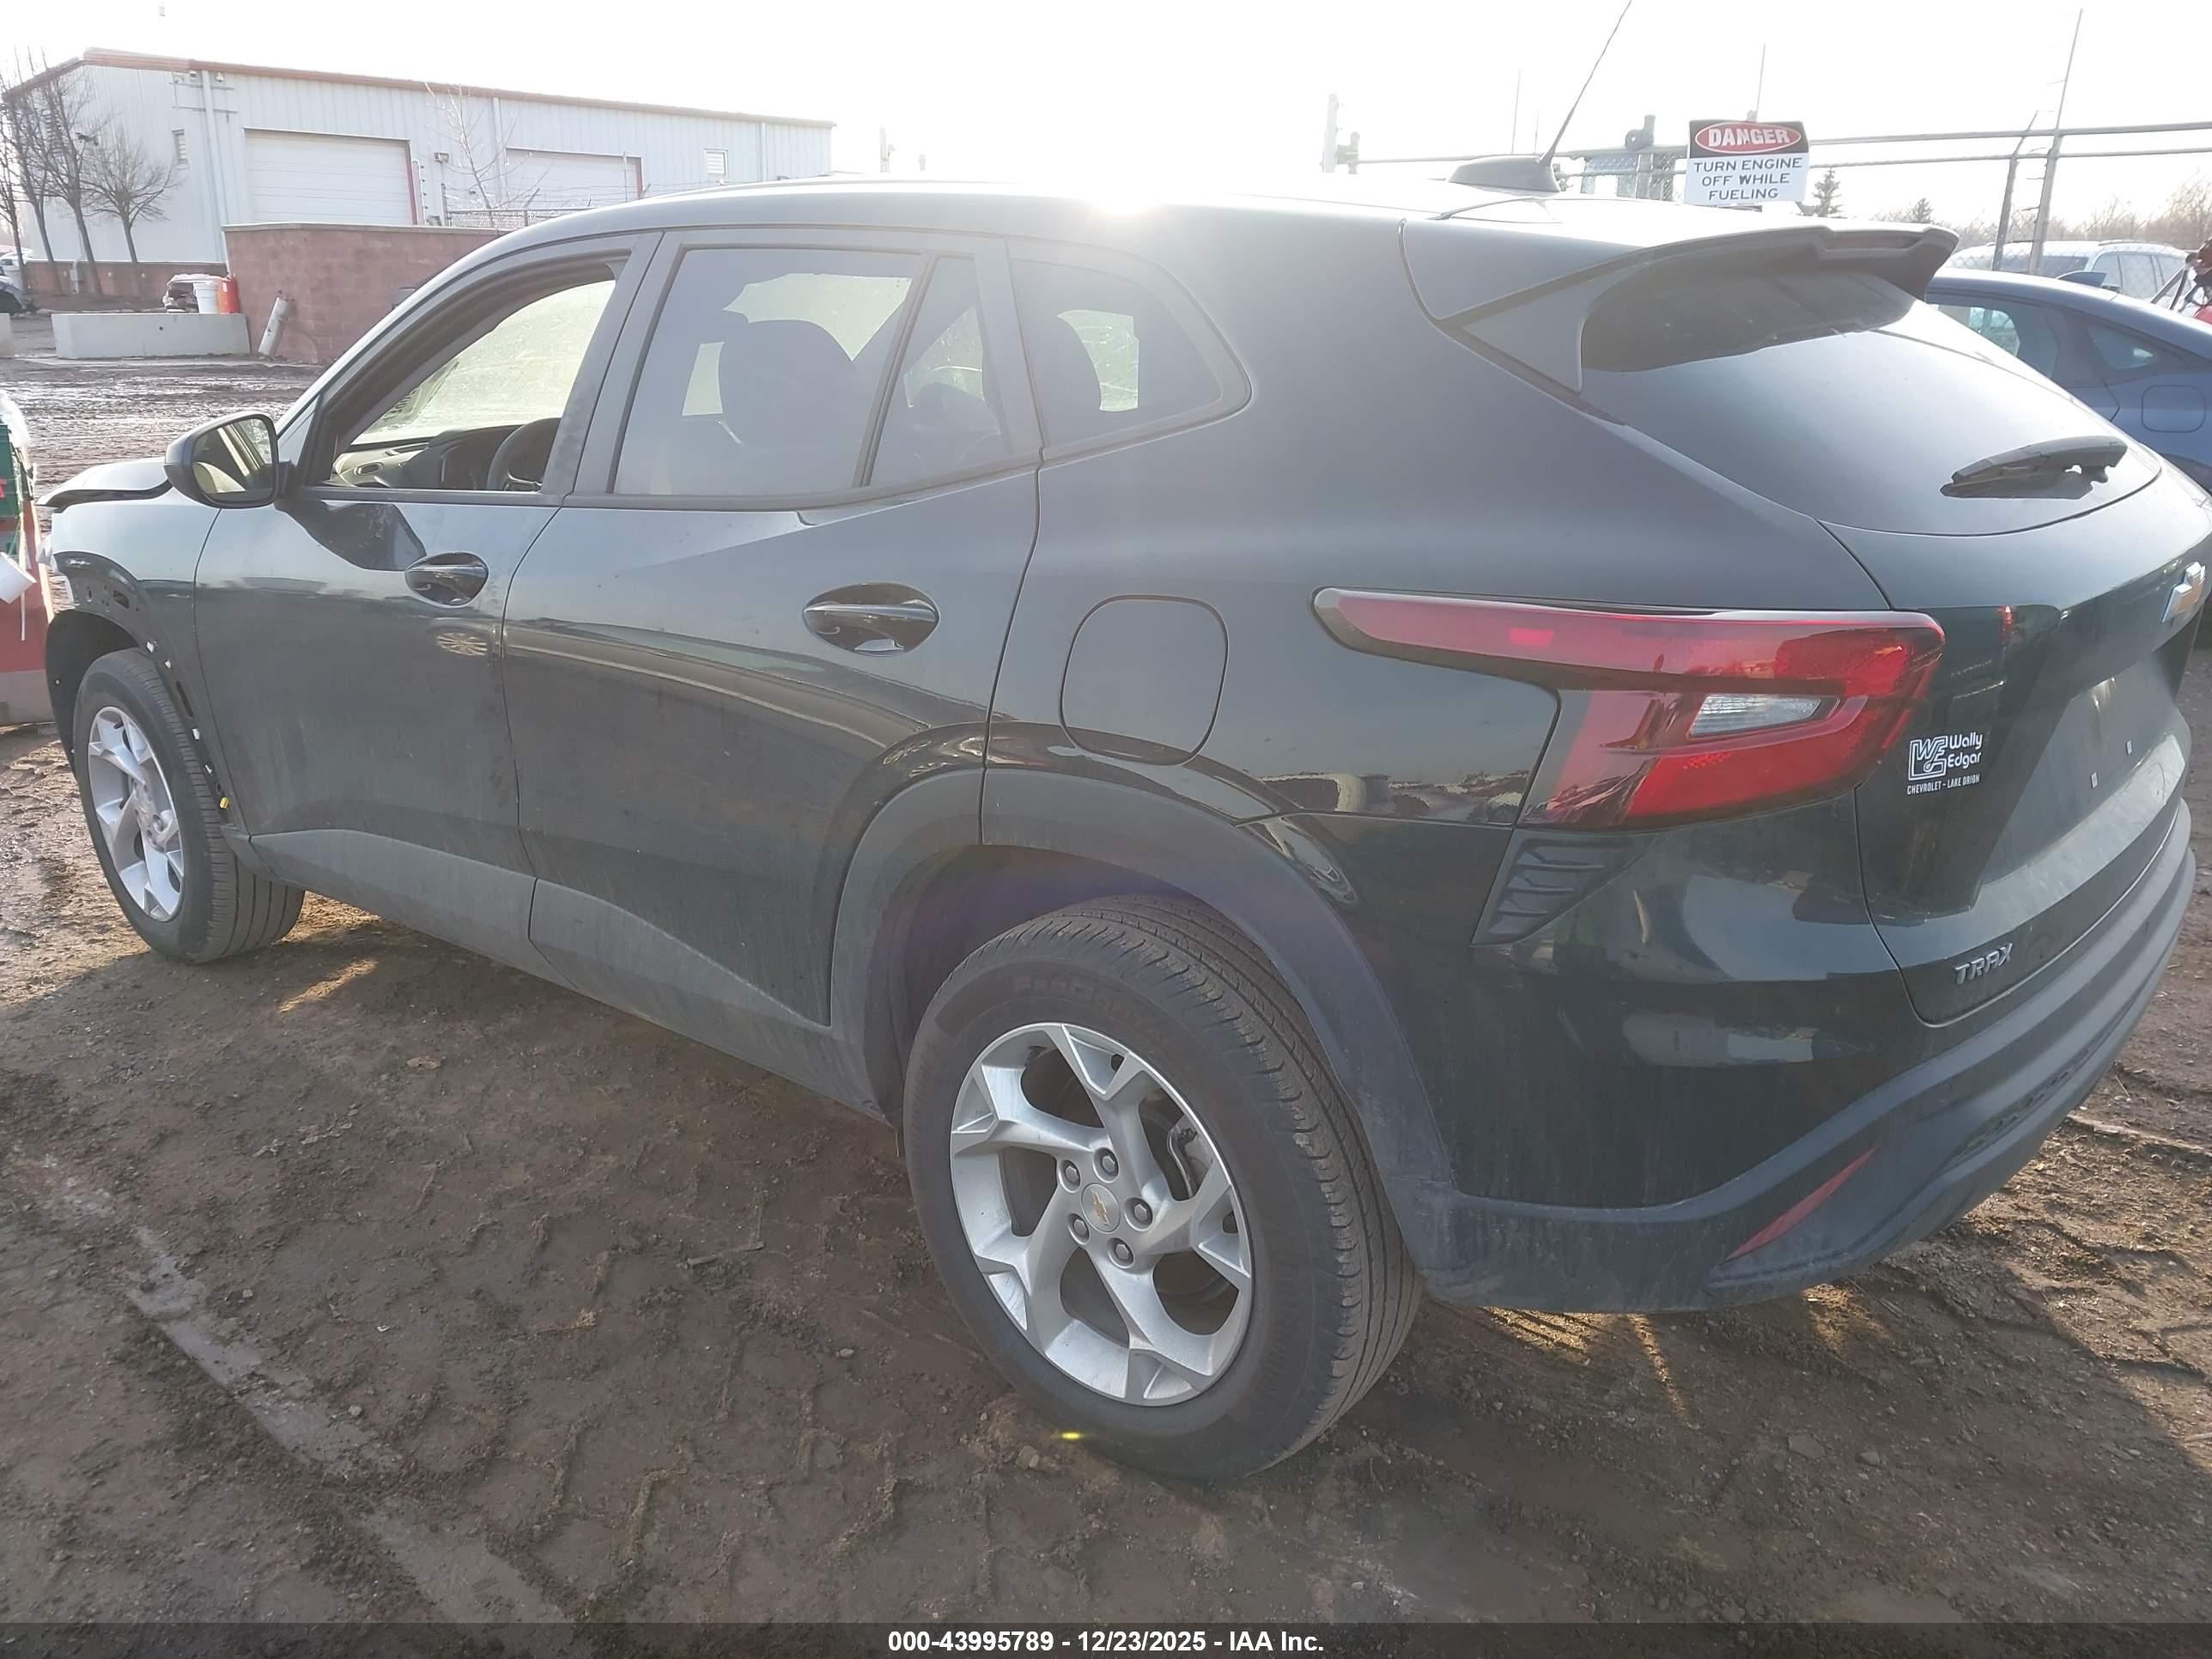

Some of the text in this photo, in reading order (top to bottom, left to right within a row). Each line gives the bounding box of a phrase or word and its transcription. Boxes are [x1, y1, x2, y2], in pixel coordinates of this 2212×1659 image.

[1708, 128, 1790, 148] DANGER
[1693, 157, 1802, 173] TURN ENGINE
[1702, 173, 1790, 186] OFF WHILE
[1709, 188, 1779, 201] FUELING
[1949, 732, 1983, 750] Wally
[1947, 751, 1982, 769] Edgar
[1907, 781, 1942, 795] CHEVROLET
[1947, 775, 1961, 789] LAKE
[1962, 774, 1980, 786] ORION
[1954, 943, 2013, 984] TRAX
